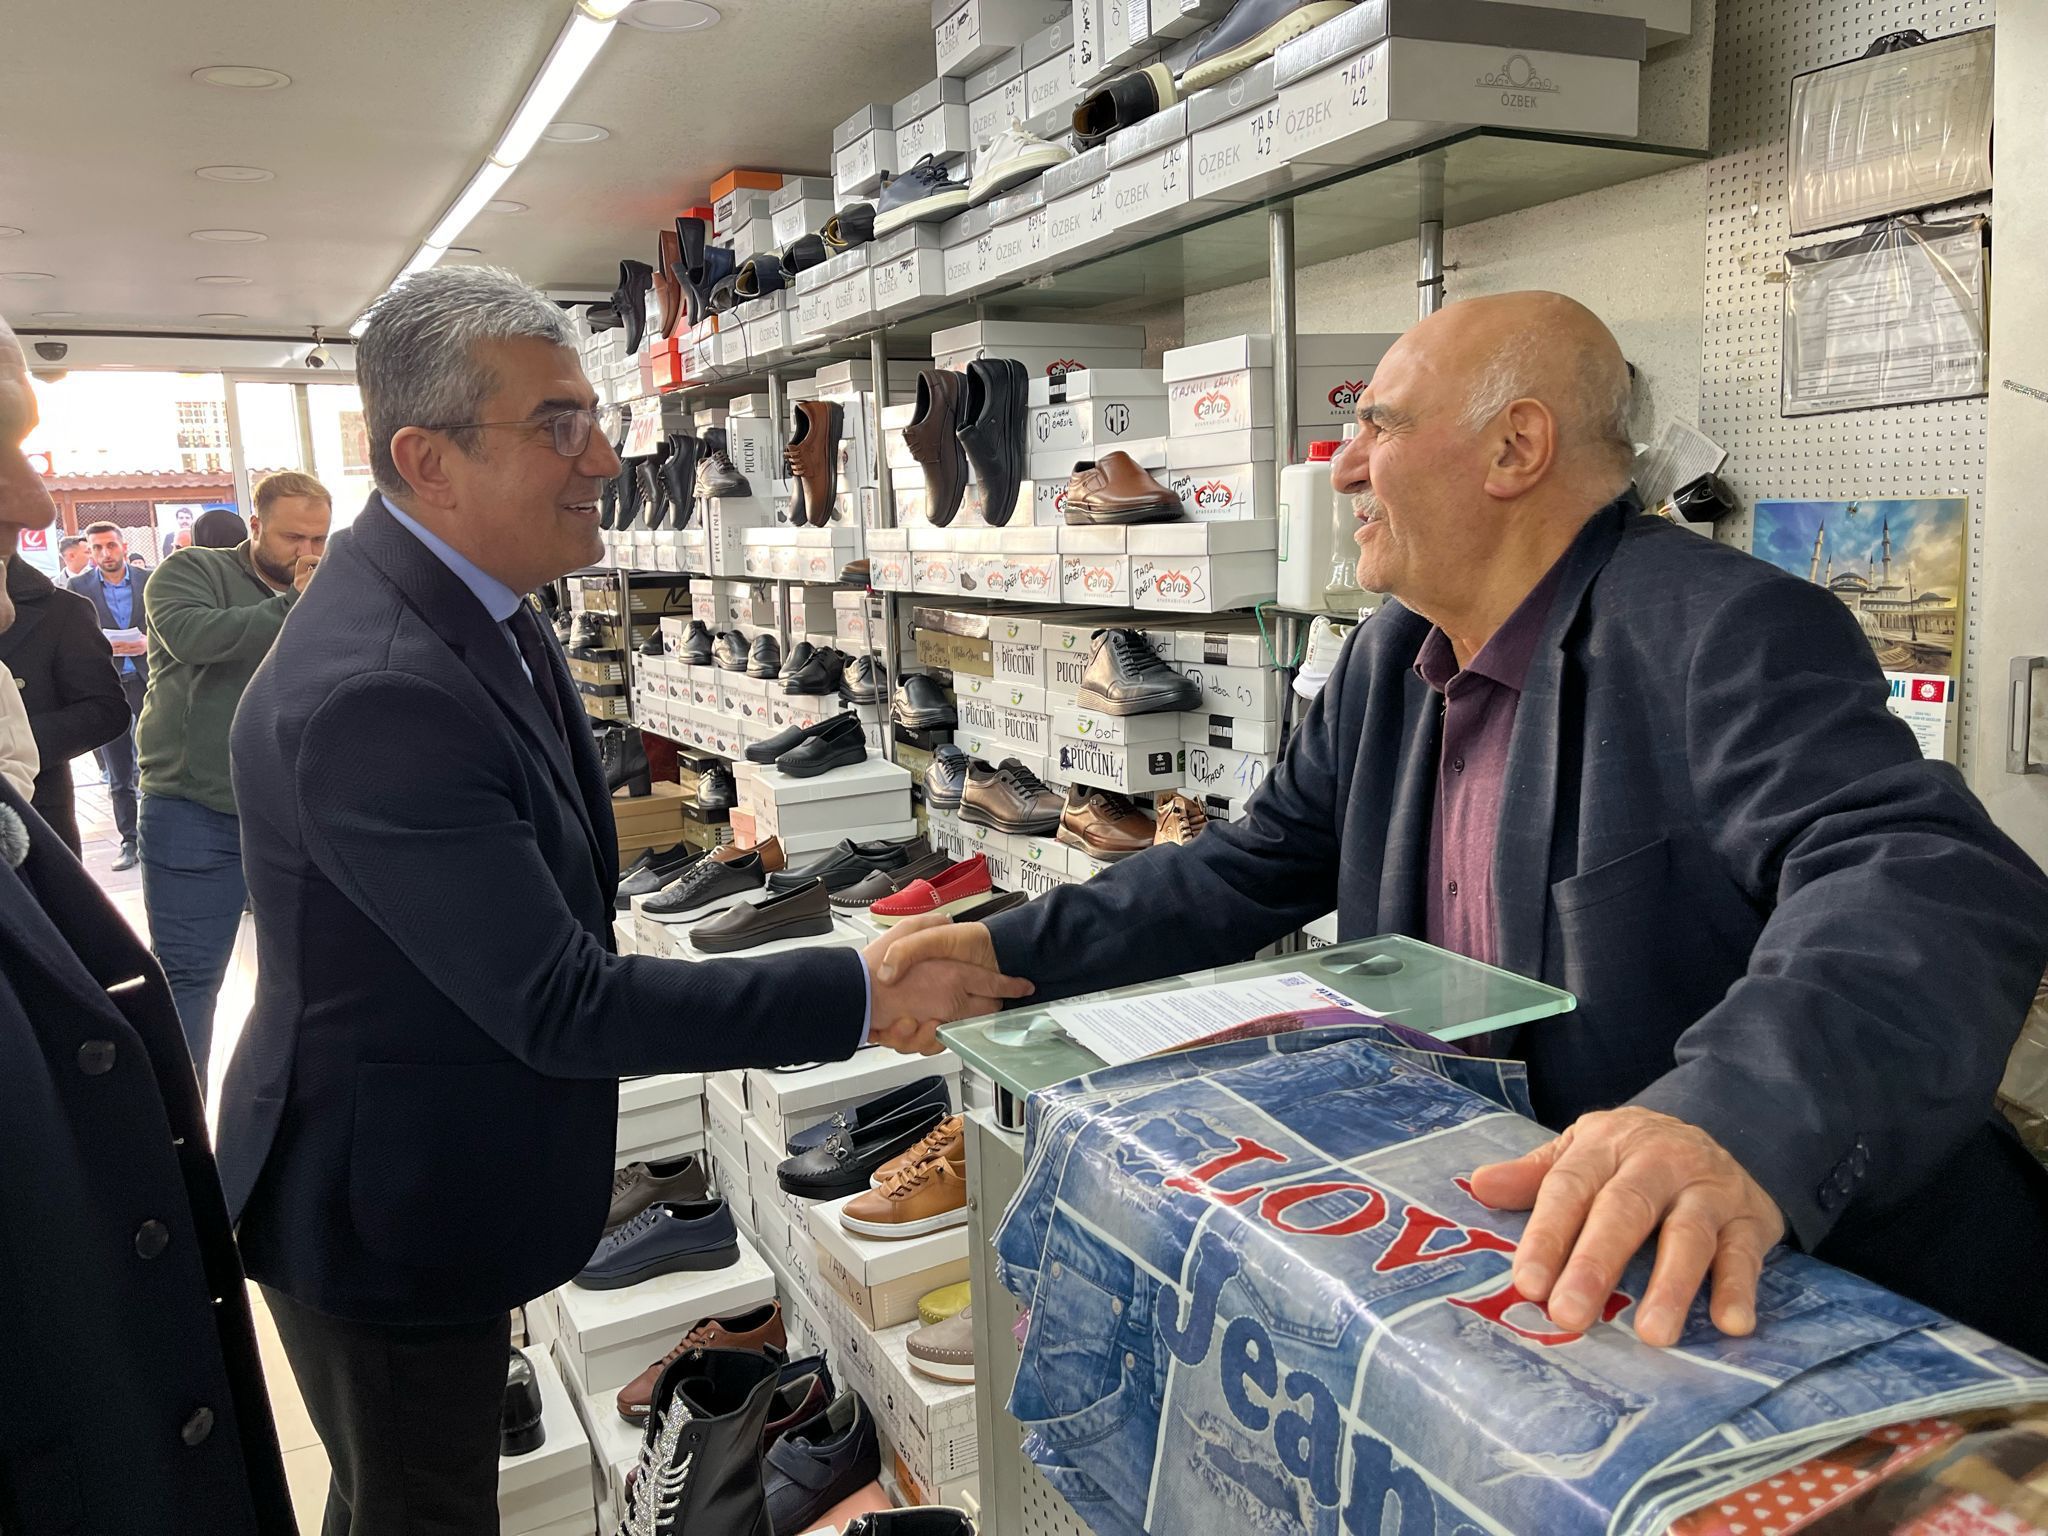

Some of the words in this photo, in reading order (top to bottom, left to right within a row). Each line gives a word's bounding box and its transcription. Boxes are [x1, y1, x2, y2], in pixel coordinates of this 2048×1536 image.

[1032, 78, 1059, 104] ÖZBEK
[1352, 85, 1368, 108] 42
[1501, 93, 1538, 109] ÖZBEK
[973, 111, 998, 134] ÖZBEK
[1285, 98, 1332, 136] ÖZBEK
[901, 138, 922, 158] ÖZBEK
[1257, 137, 1271, 156] 42
[1198, 144, 1241, 176] ÖZBEK
[1162, 171, 1177, 192] 42
[1115, 183, 1150, 209] ÖZBEK
[1051, 214, 1081, 238] ÖZBEK
[996, 239, 1022, 261] ÖZBEK
[947, 260, 971, 280] ÖZBEK
[744, 437, 755, 474] PUCCINI
[713, 514, 721, 563] PUCCINI
[1190, 566, 1206, 604] 3
[1095, 719, 1120, 739] bot
[1071, 748, 1116, 777] PUCCİNİ
[1205, 764, 1225, 786] TABA
[1020, 860, 1042, 873] TABA
[1155, 1231, 1486, 1536] Jean
